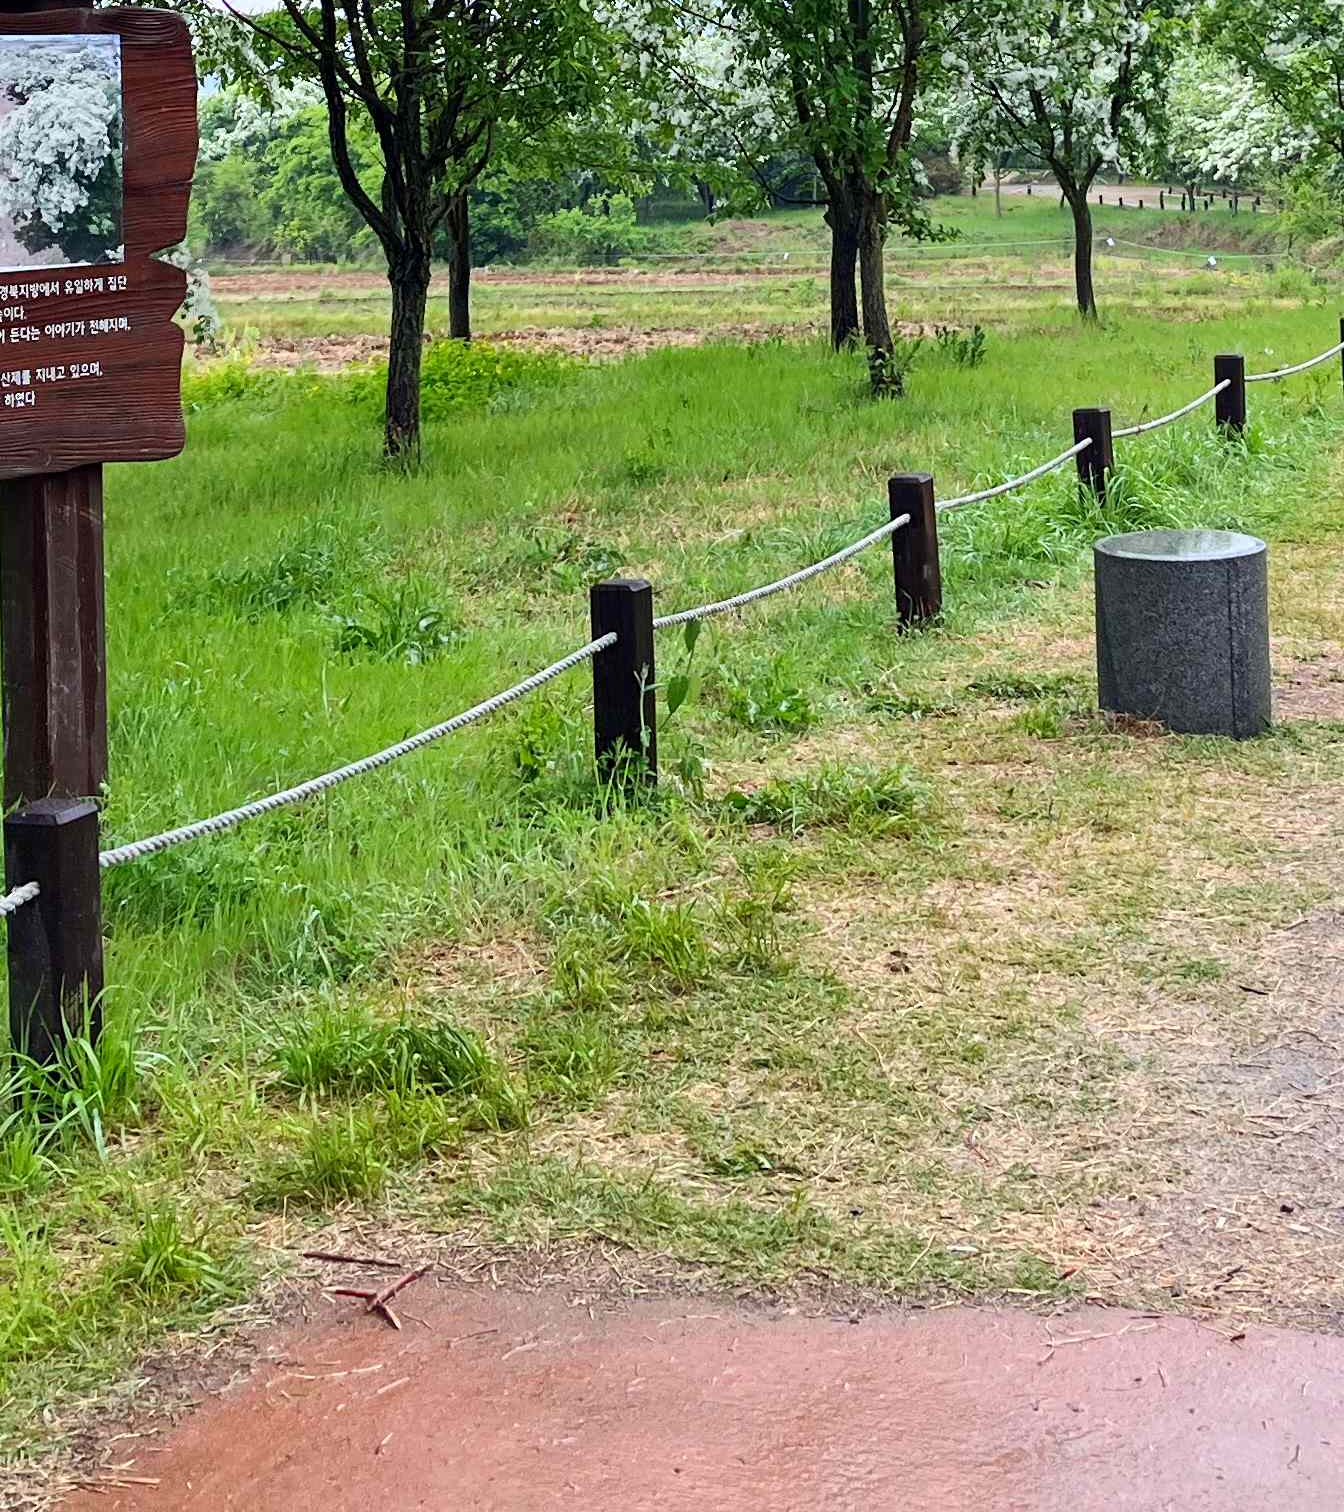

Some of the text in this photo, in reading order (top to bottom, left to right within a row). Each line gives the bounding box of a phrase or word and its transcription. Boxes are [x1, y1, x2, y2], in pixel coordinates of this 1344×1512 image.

[64, 277, 104, 295] 유일하게
[107, 275, 127, 292] 집단
[9, 326, 41, 343] 든다는
[44, 321, 86, 338] 이야기가
[35, 365, 66, 383] 지내고
[4, 391, 36, 408] 하였다
